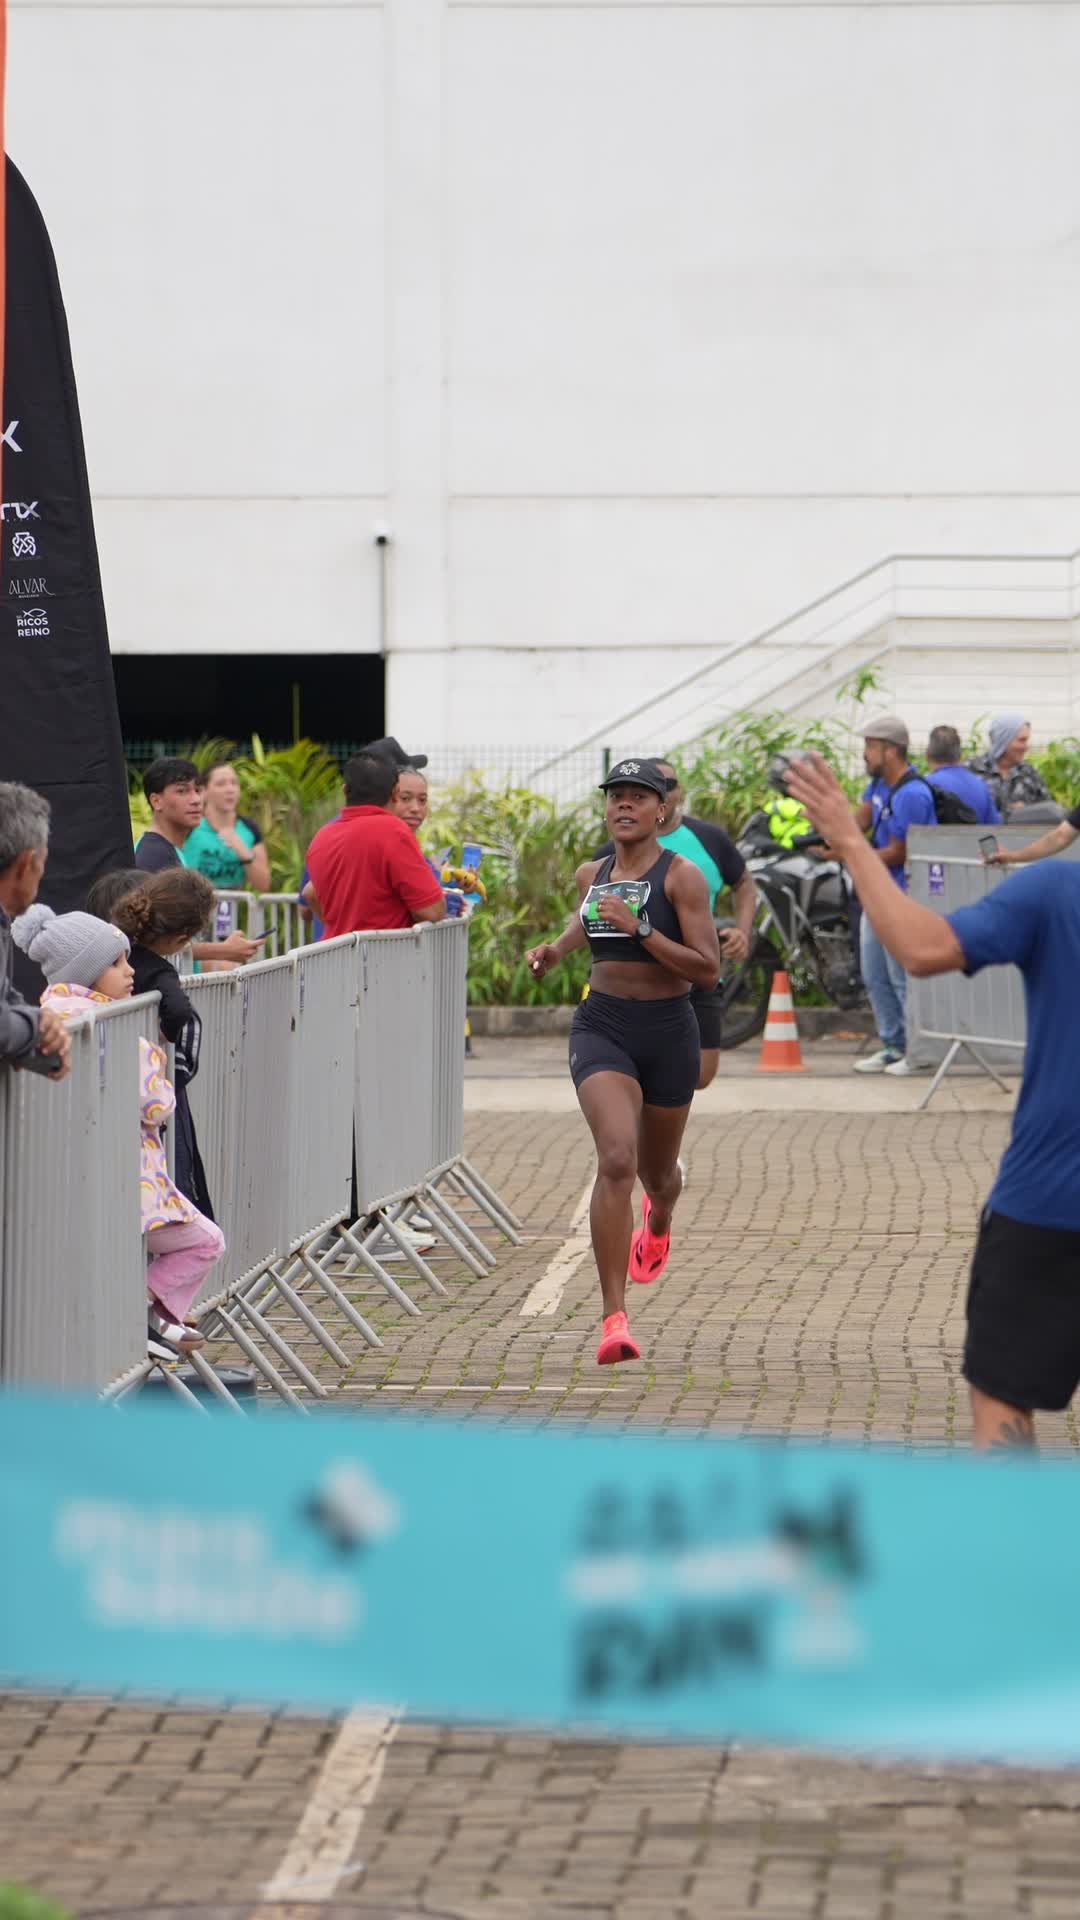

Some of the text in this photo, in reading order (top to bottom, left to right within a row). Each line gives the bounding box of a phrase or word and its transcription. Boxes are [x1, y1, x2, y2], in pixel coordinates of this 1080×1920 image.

[8, 577, 56, 596] ALVAR
[16, 617, 48, 627] RICOS
[17, 627, 50, 637] REINO
